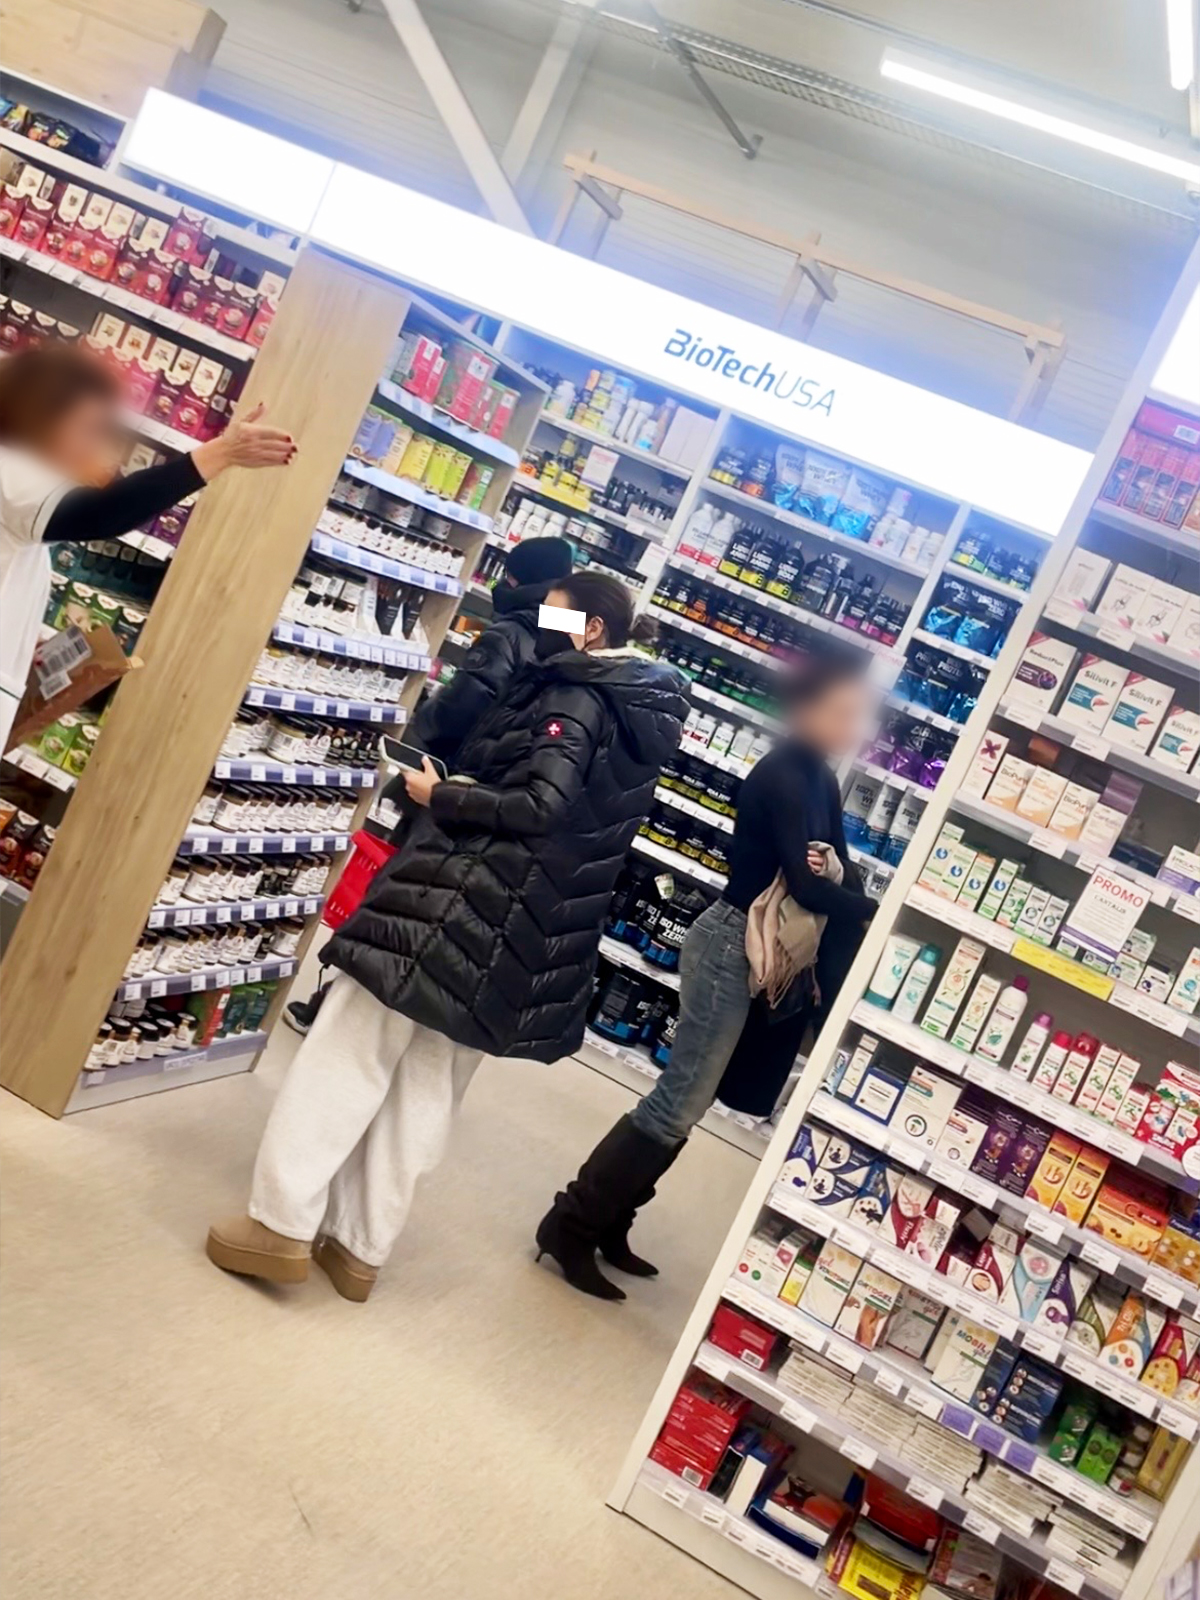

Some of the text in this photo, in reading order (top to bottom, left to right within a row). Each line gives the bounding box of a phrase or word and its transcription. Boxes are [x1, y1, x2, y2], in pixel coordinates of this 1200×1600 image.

[663, 328, 836, 417] BioTechUSA
[1083, 670, 1118, 688] Silivit F
[1128, 688, 1162, 707] Silivit F
[1093, 874, 1144, 908] PROMO
[658, 916, 688, 935] ISO WH
[662, 928, 687, 943] ZERO
[857, 1279, 893, 1304] ORTOGEL
[956, 1329, 987, 1351] MOBIL
